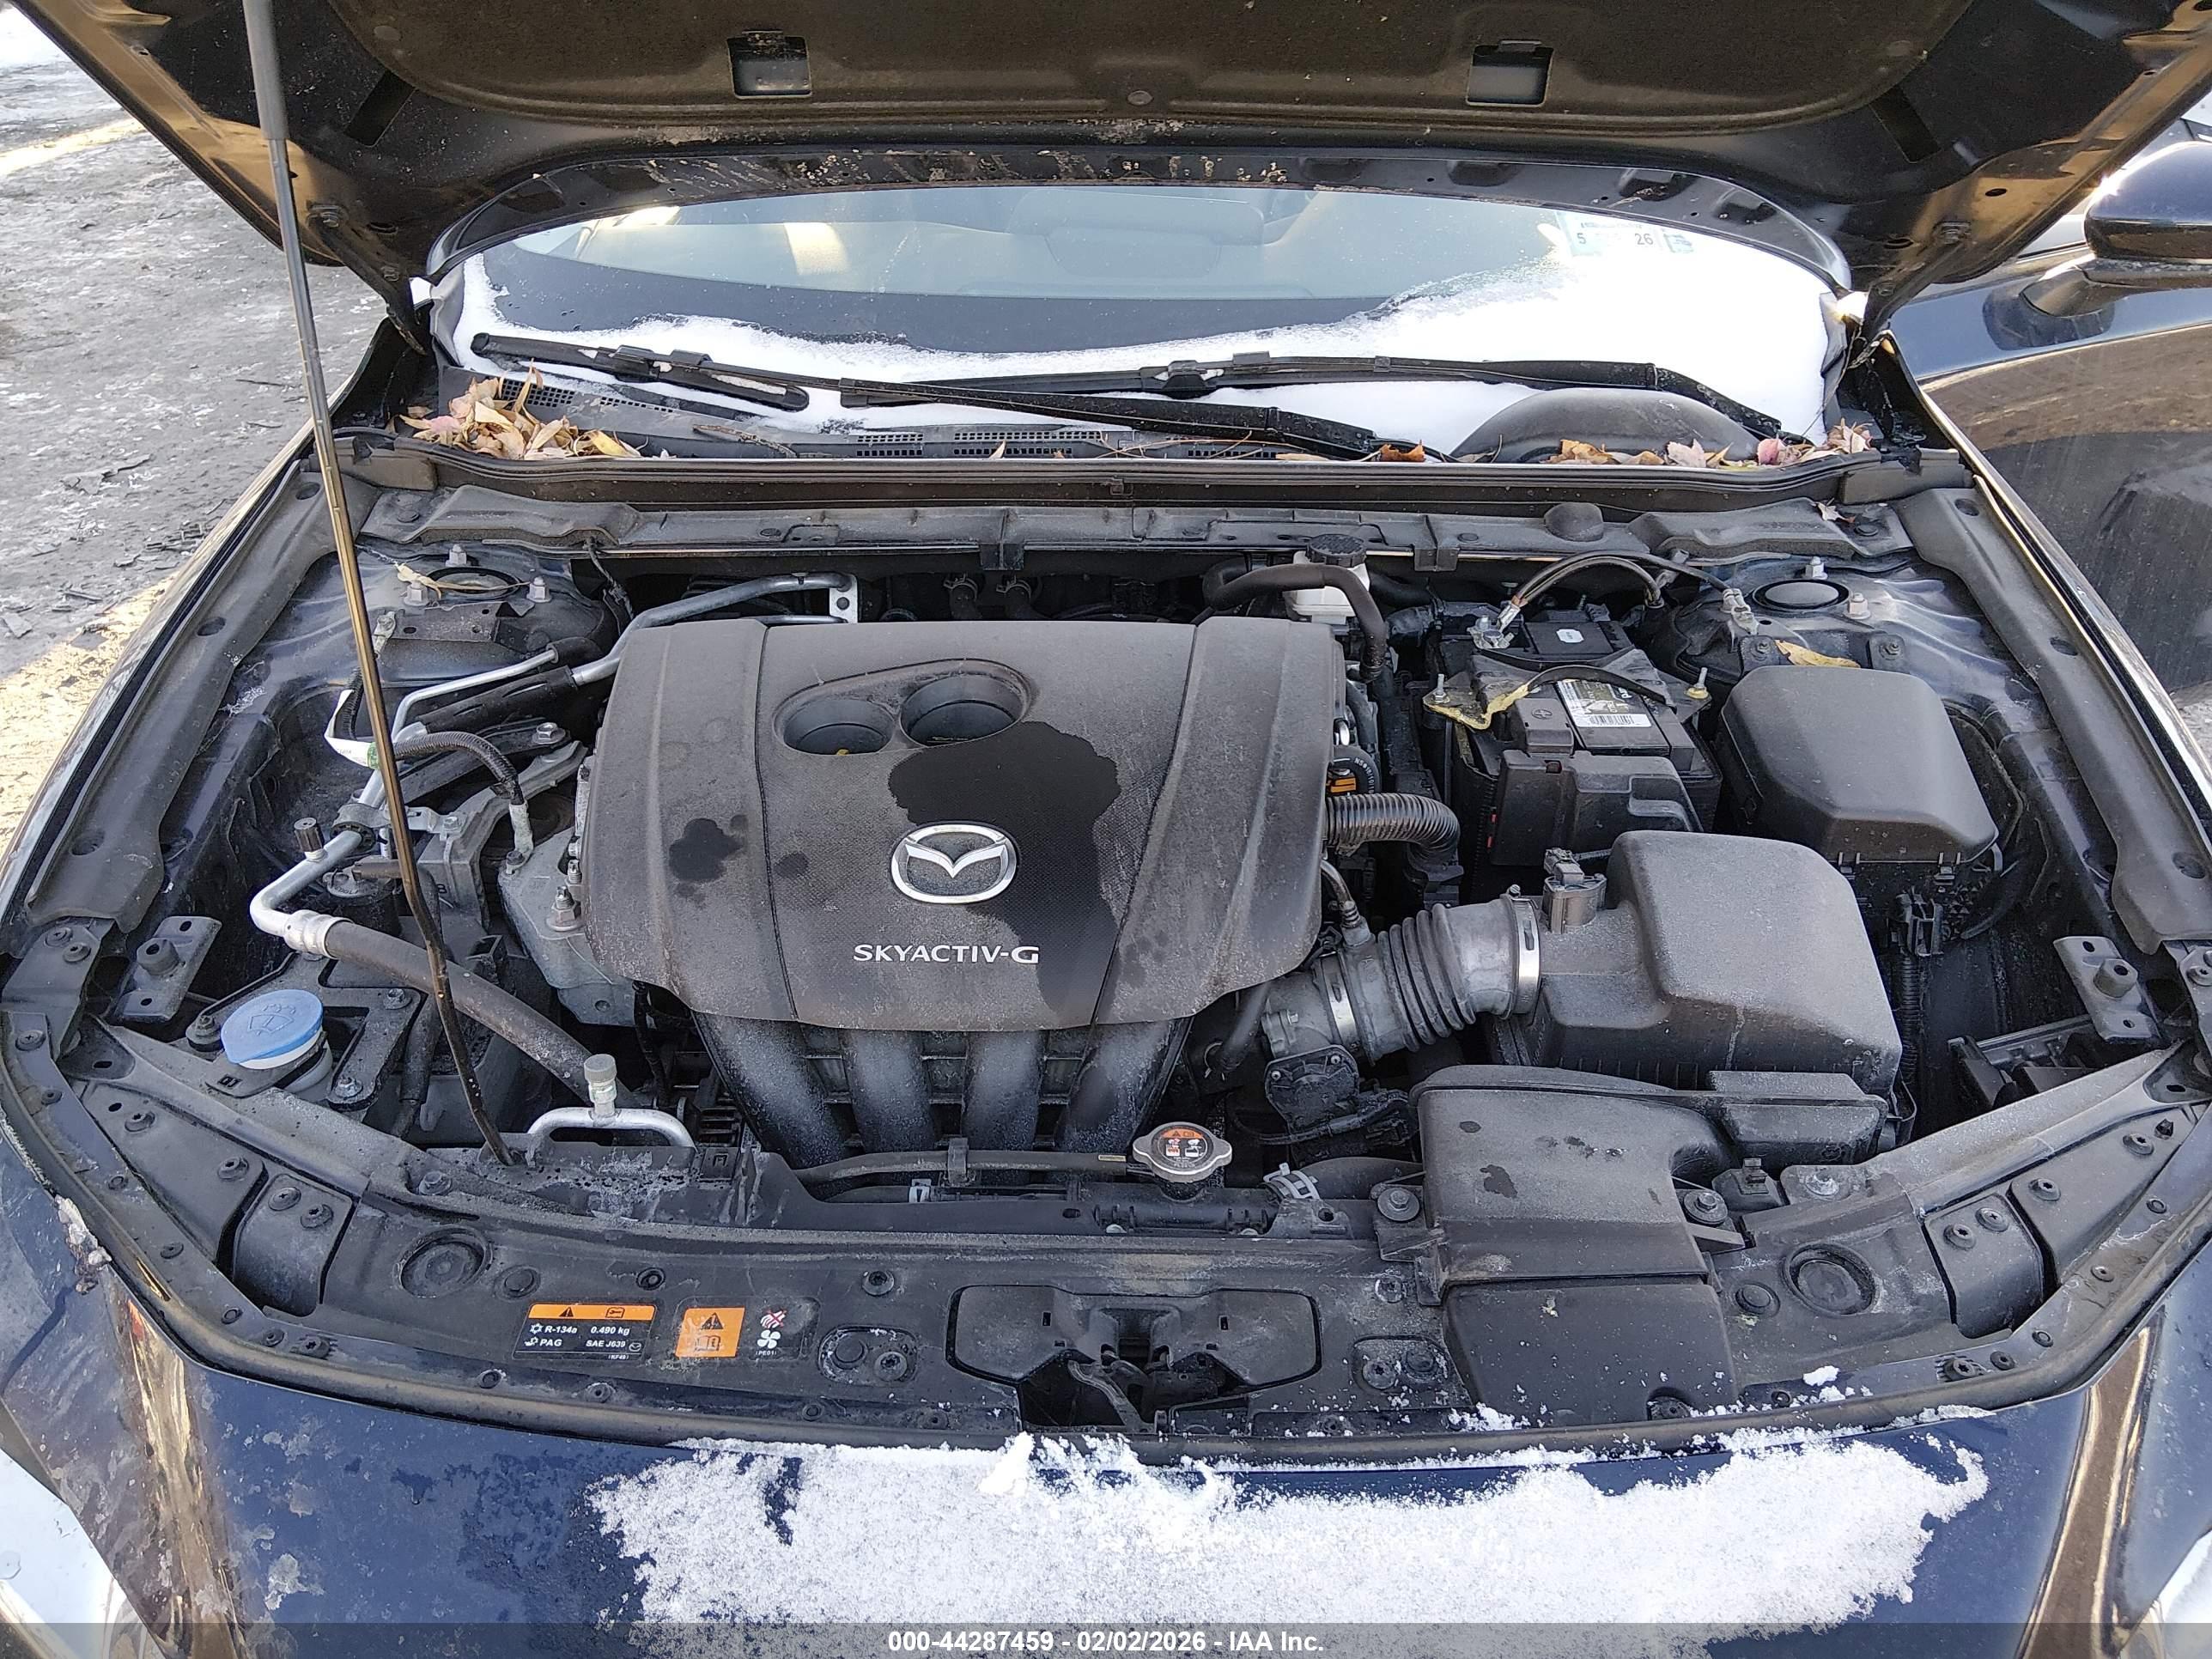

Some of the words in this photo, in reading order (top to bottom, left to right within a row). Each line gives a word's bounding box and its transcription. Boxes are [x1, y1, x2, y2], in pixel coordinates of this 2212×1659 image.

[1576, 232, 1587, 245] 5
[1634, 233, 1654, 246] 26
[853, 944, 1040, 964] SKYACTIV-G
[544, 1325, 578, 1334] R-134a
[590, 1326, 617, 1334] 0.490
[617, 1326, 630, 1336] kg
[539, 1339, 562, 1347] PAG
